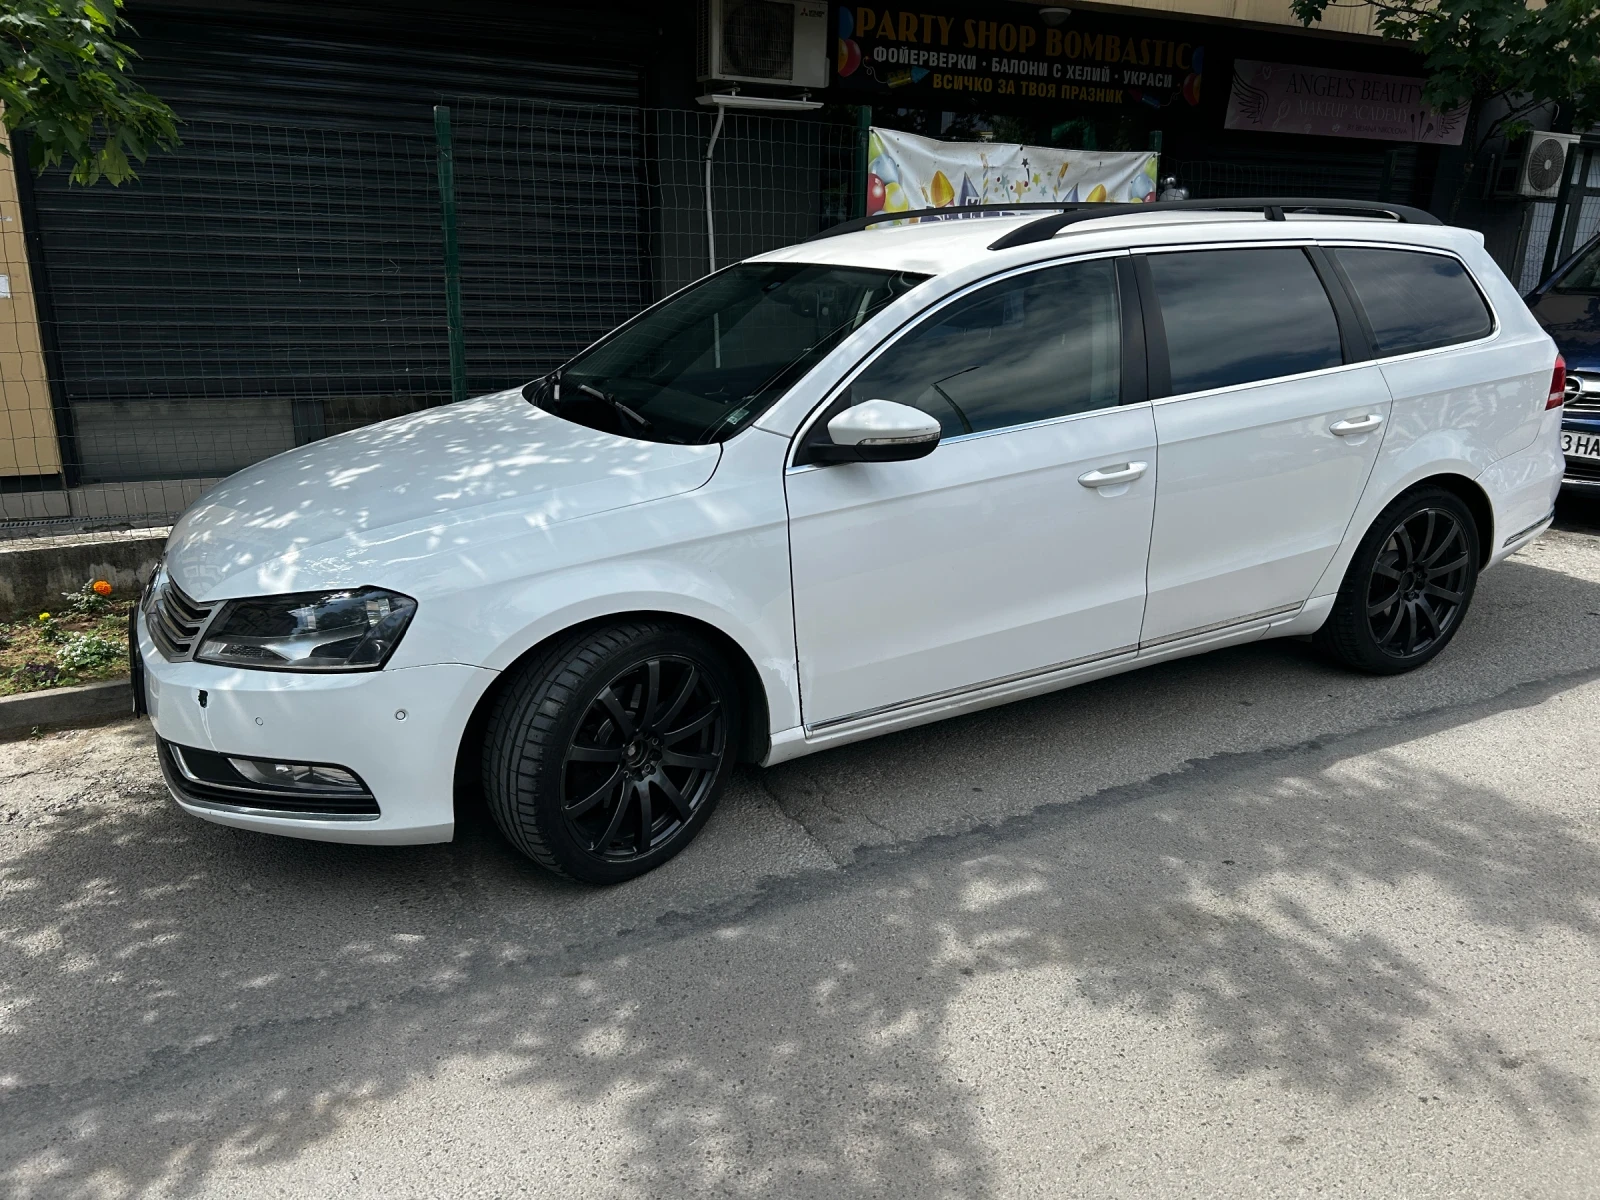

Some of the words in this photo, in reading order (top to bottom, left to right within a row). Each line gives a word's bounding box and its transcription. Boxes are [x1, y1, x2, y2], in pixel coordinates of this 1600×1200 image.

[856, 6, 955, 46] PARTY
[962, 18, 1036, 54] SHOP
[1045, 28, 1191, 70] BOMBASTIC
[873, 46, 977, 71] ФОЙЕРВЕРКИ
[991, 57, 1048, 77] БАЛОНИ
[1052, 63, 1062, 78] С
[1065, 64, 1111, 83] ХЕЛИЙ
[1123, 70, 1173, 88] УКРАСИ
[932, 73, 993, 93] ВСИЧКО
[998, 79, 1015, 95] ЗА
[1021, 80, 1056, 98] ТВОЯ
[1061, 84, 1124, 104] ПРАЗНИК
[1286, 72, 1356, 99] ANGEL'S
[1297, 99, 1348, 118] MAKEUP
[1350, 104, 1408, 123] ACADEMY
